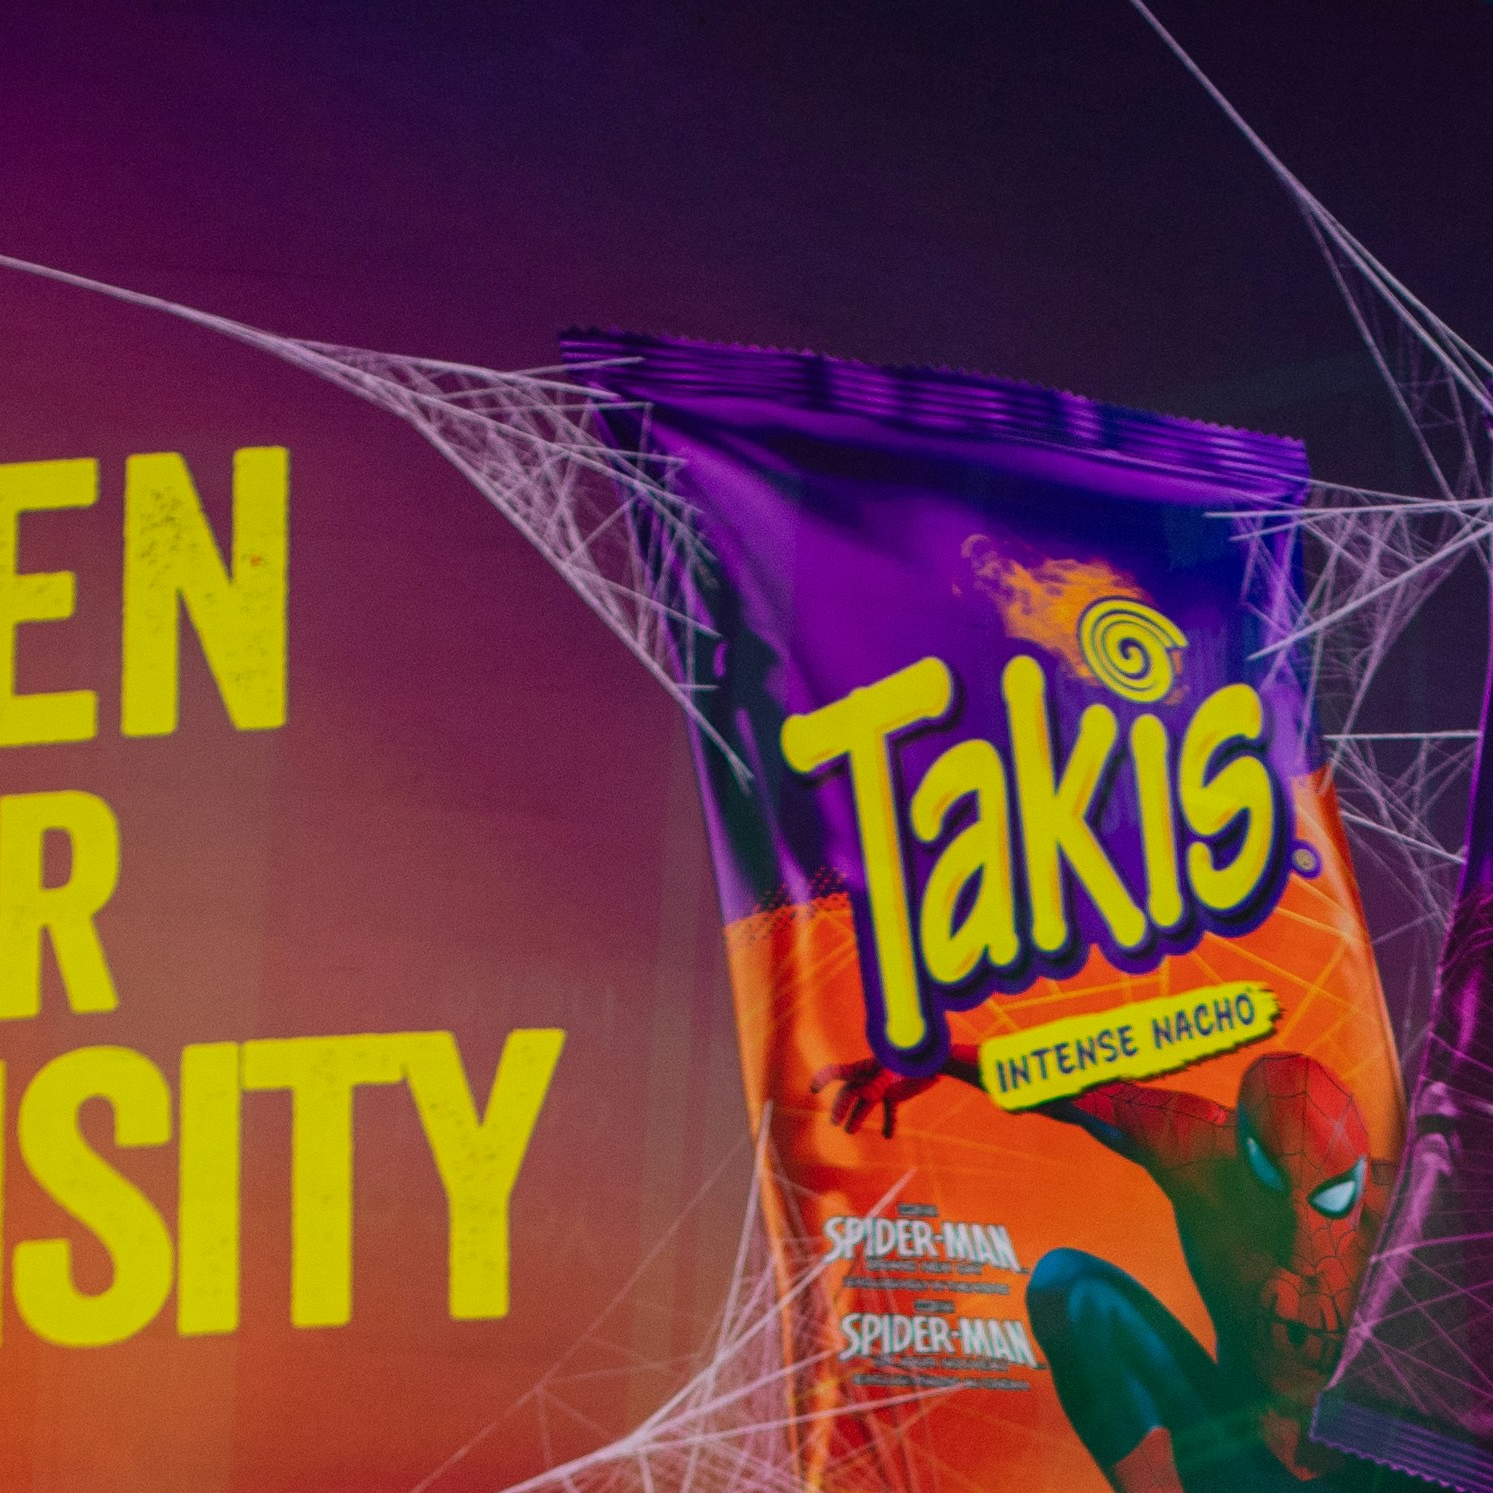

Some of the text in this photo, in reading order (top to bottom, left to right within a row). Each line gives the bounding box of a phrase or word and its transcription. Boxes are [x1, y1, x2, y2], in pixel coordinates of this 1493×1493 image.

[778, 597, 1276, 1050] Takis
[996, 994, 1257, 1093] INTENSE NACHO
[822, 1216, 1022, 1272] SPIDER-MAN
[838, 1312, 1038, 1369] SPIDER-MAN
